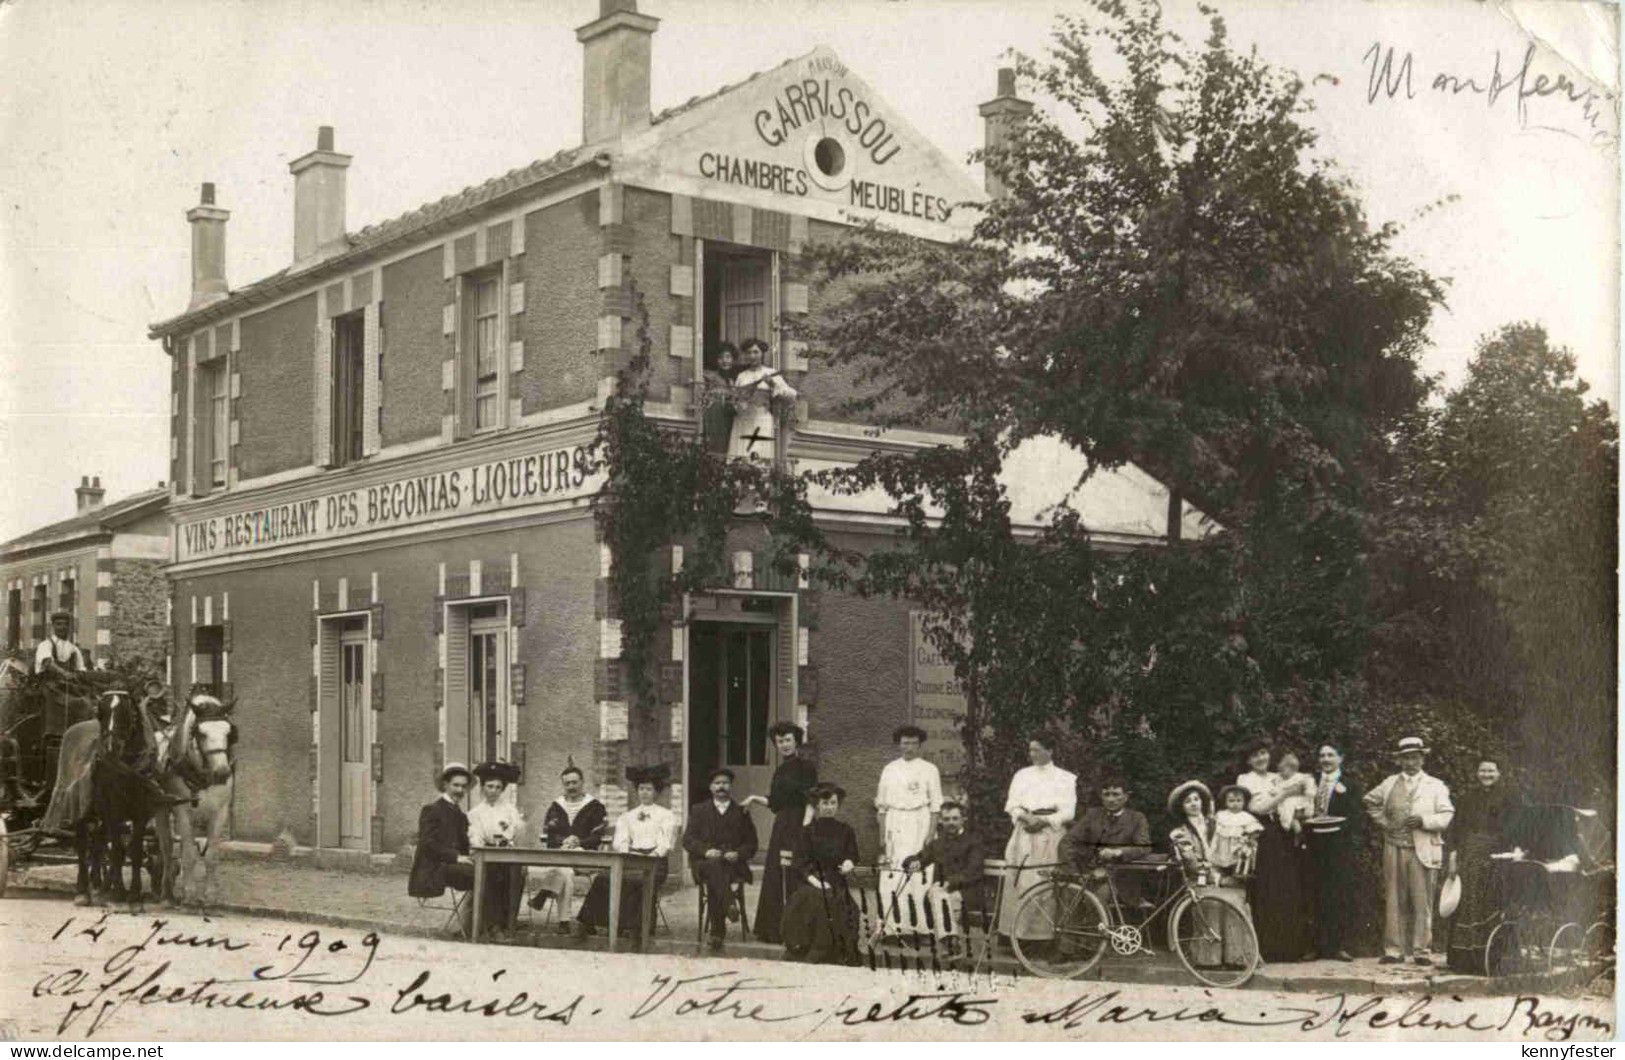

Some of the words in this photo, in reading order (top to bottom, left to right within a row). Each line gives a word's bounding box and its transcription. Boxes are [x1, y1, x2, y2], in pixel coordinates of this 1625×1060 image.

[754, 78, 901, 165] GARRISSOU
[699, 152, 808, 196] CHAMBRES
[850, 180, 951, 223] MEUBLÉES
[183, 517, 217, 555] VINS
[224, 502, 319, 548] RESTAURANT
[326, 492, 358, 530] DES
[471, 445, 586, 505] LIQUEURS
[254, 930, 380, 984] 1909
[630, 971, 806, 1022] Votre
